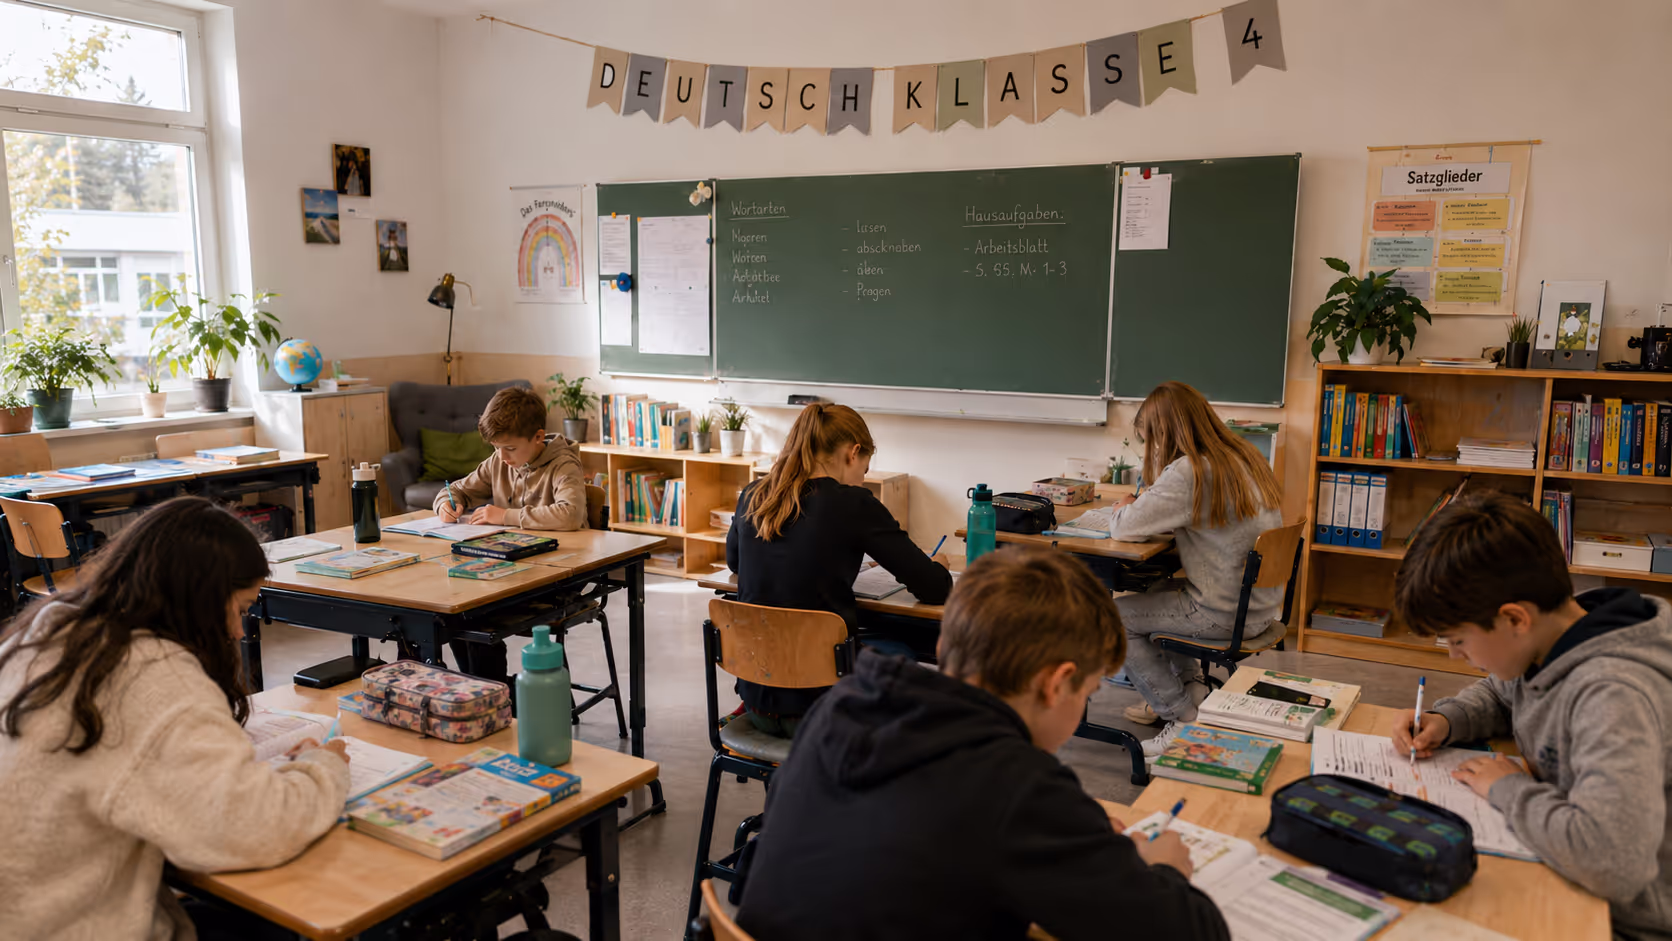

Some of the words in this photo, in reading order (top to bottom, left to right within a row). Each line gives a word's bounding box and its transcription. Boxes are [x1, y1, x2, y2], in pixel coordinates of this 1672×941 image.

[600, 62, 858, 111] DEUTSCH
[906, 41, 1177, 109] KLASSE
[1240, 18, 1263, 50] 4
[1407, 168, 1483, 187] Satzglieder
[731, 201, 786, 216] Wortarten
[974, 238, 1049, 255] Arbeitsblatt
